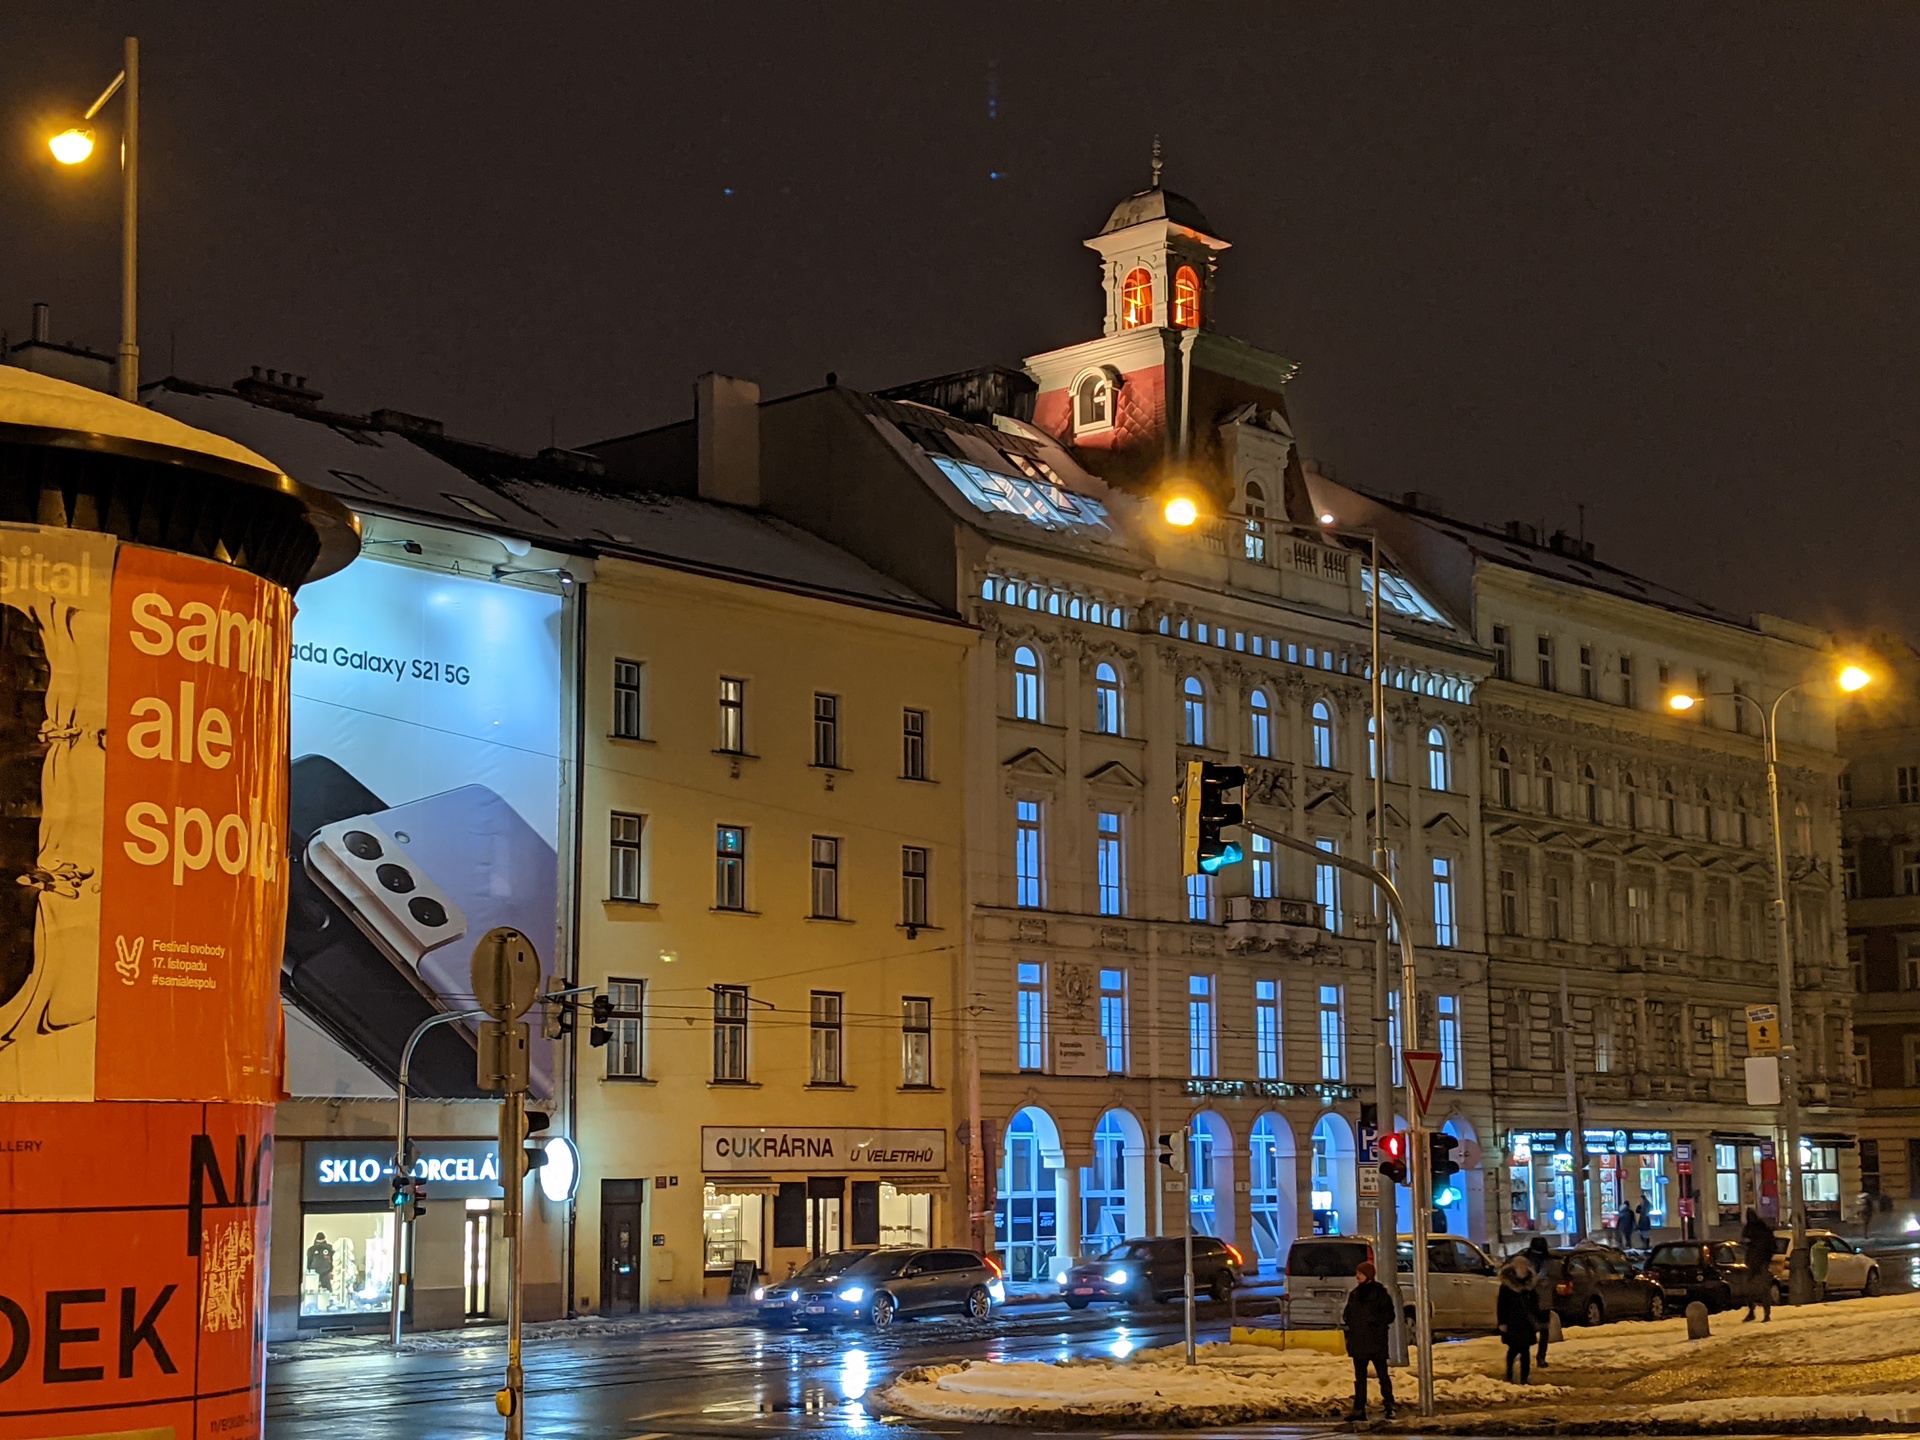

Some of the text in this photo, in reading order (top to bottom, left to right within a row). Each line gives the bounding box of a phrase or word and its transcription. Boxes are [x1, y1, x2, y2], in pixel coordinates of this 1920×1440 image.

[129, 592, 272, 682] sami
[333, 647, 406, 682] Galaxy
[411, 659, 439, 681] S21
[445, 664, 470, 685] 5G
[127, 681, 232, 770] ale
[123, 797, 277, 887] spolu
[152, 957, 166, 969] 17.
[190, 943, 225, 959] svobody
[716, 1134, 934, 1162] CUKRÁRNA U VELETRHŮ
